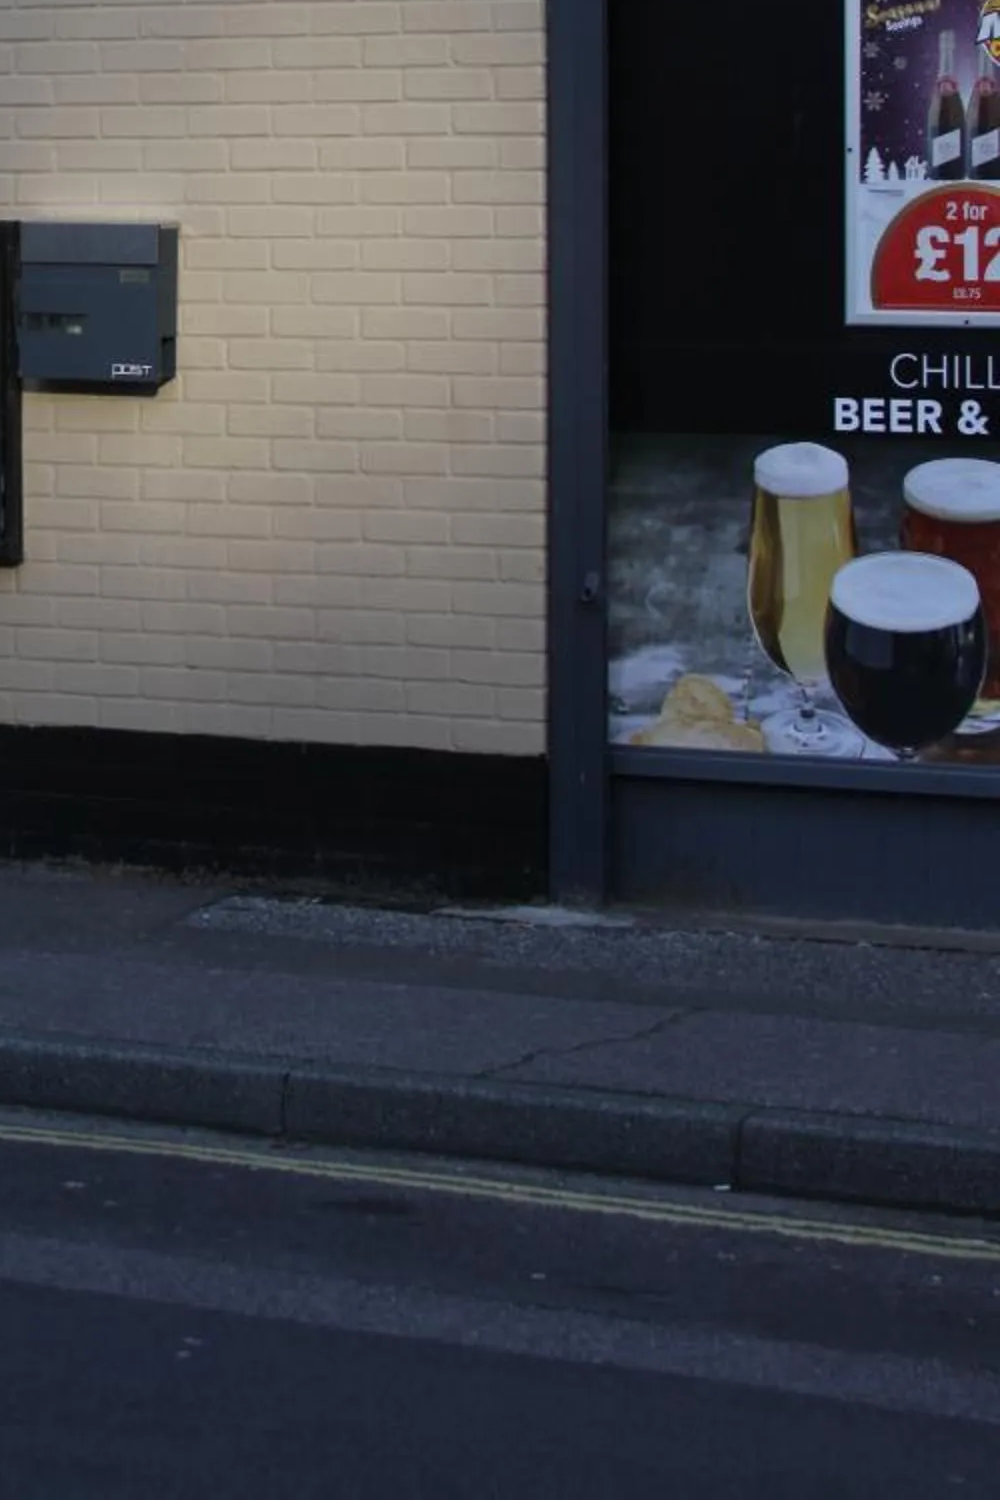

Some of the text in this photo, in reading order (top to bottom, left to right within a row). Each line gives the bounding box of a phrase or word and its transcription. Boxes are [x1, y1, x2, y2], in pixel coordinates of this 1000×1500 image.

[945, 200, 989, 221] 2 for
[890, 352, 1000, 389] CHILL
[834, 397, 990, 436] BEER &
